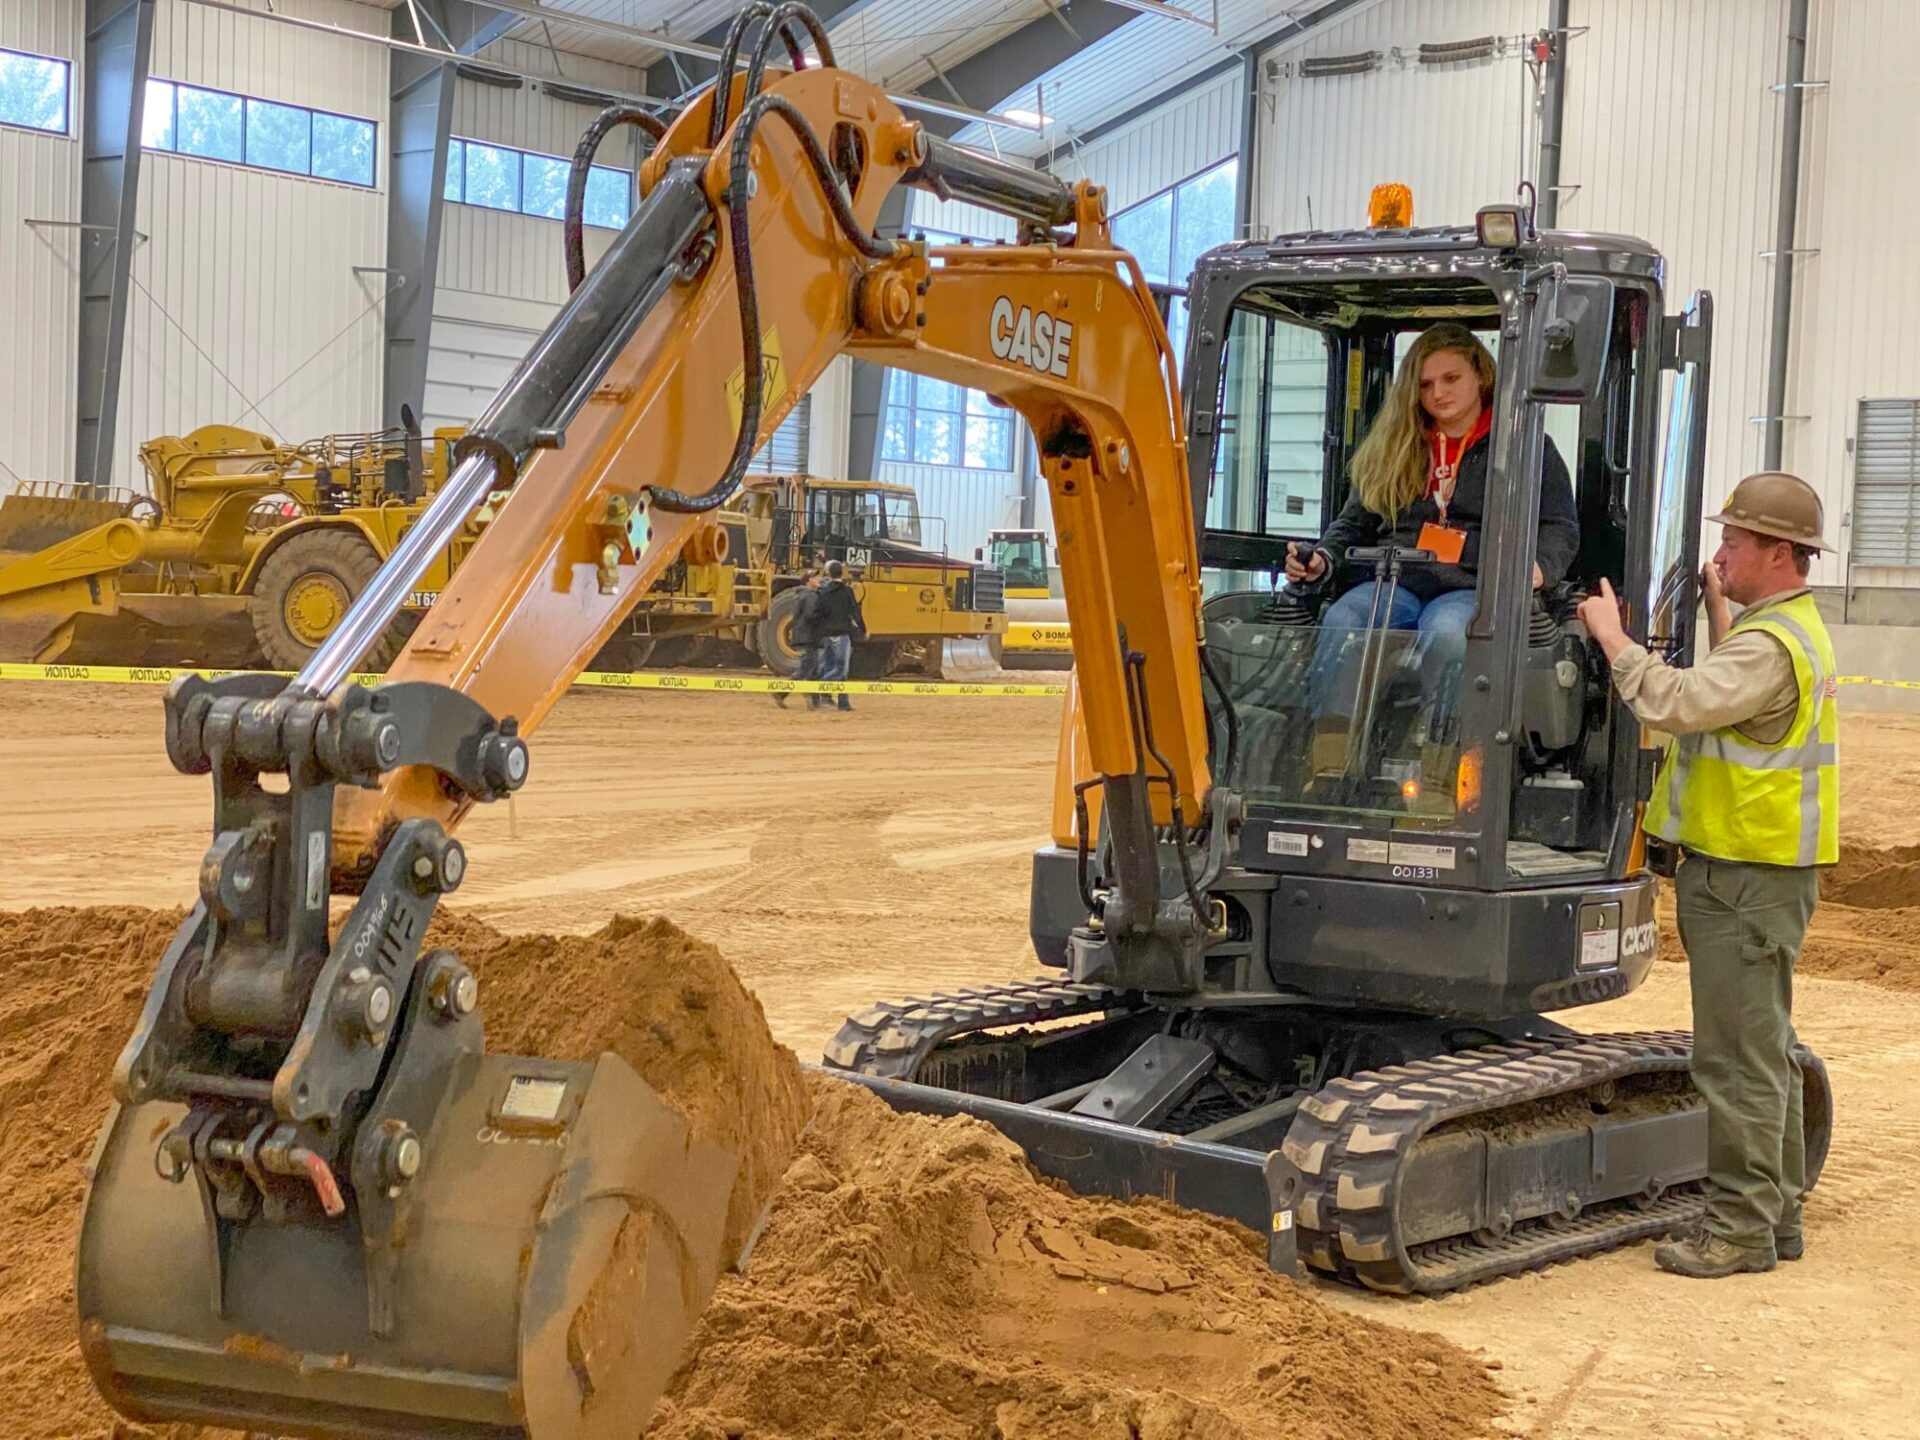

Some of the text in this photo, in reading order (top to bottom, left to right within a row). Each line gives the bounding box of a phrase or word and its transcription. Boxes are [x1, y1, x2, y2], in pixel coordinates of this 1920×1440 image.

[989, 295, 1073, 379] CASE
[846, 546, 872, 566] CAT
[1045, 631, 1072, 640] BOMA
[1392, 865, 1439, 880] 001331
